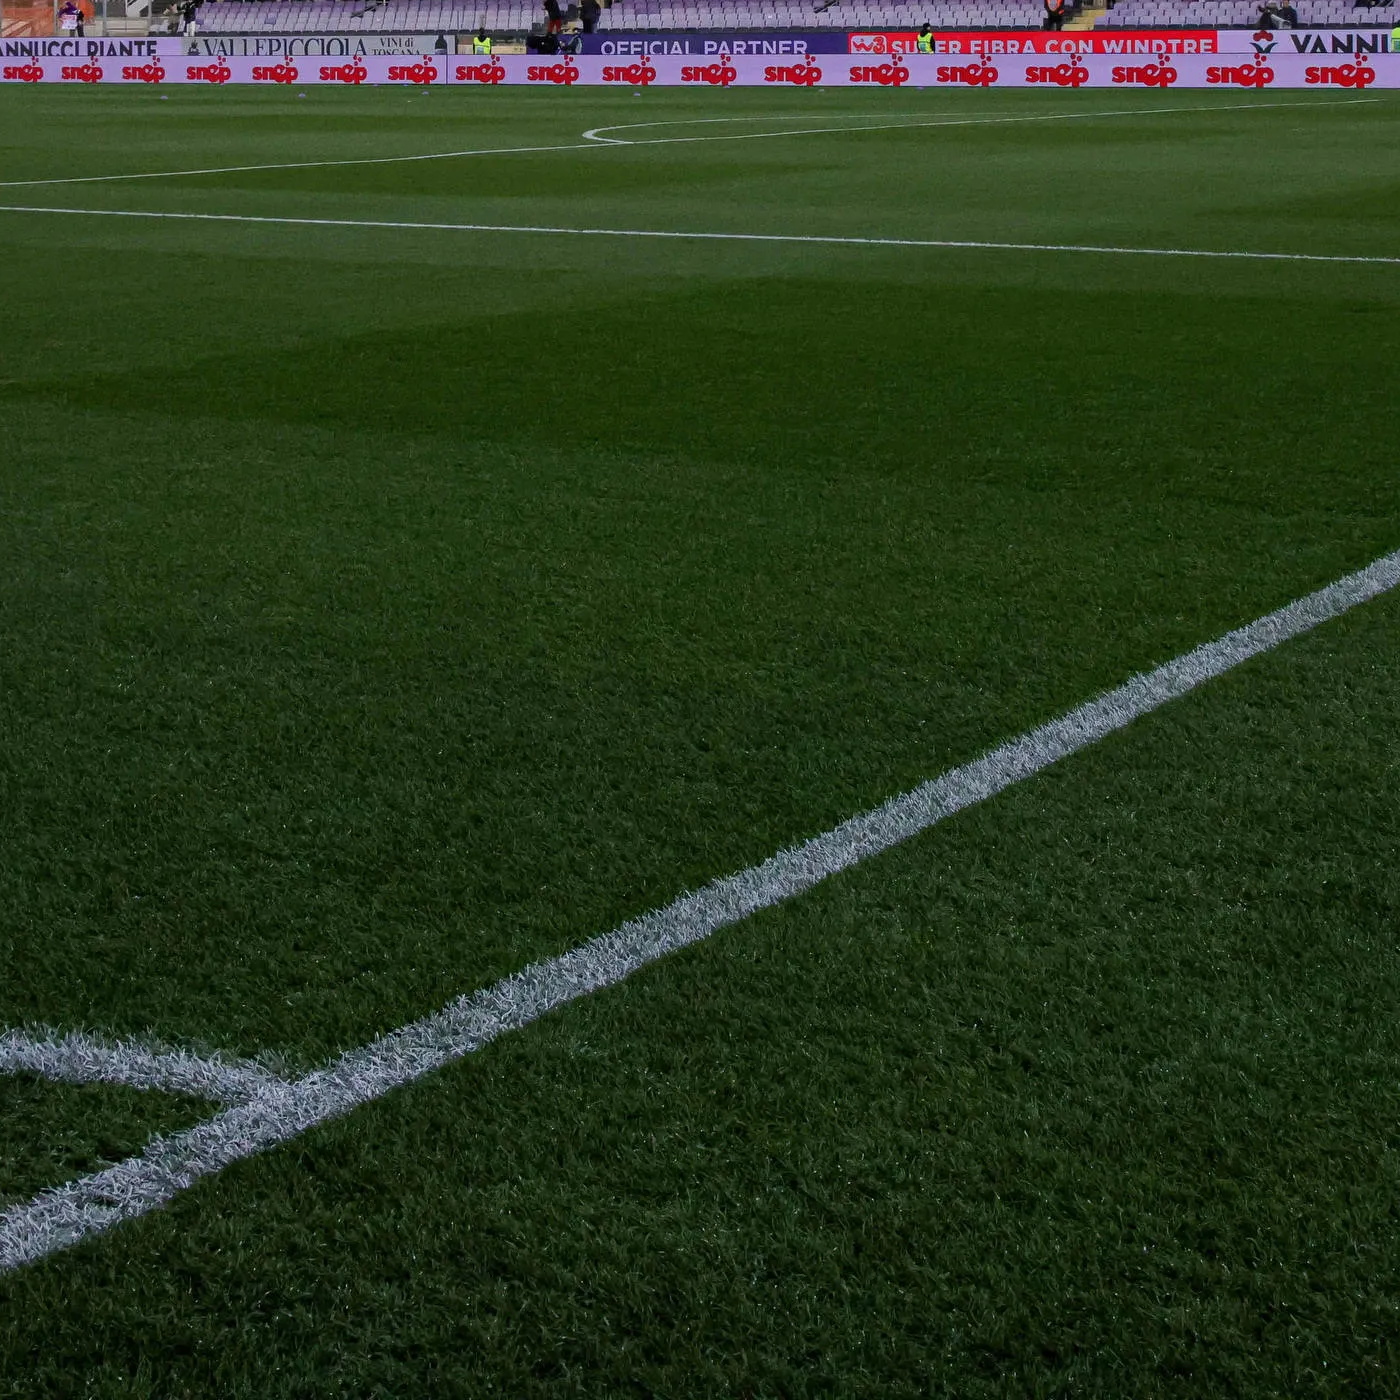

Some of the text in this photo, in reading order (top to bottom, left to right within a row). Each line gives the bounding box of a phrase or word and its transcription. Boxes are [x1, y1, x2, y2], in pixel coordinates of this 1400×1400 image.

[88, 41, 158, 56] PIANTE
[380, 38, 414, 48] VINI di
[600, 40, 808, 54] OFFICIAL PARTNER
[892, 38, 1212, 53] SUER FIBRA CON WINDTRE
[3, 64, 44, 82] snep
[62, 64, 104, 83] snep
[122, 64, 166, 84] snep
[186, 64, 232, 84] snep
[252, 64, 298, 84] snep
[320, 64, 368, 84] snep
[388, 64, 438, 84] snep
[456, 64, 506, 84] snep
[527, 64, 580, 85] snep
[602, 64, 656, 86] snep
[681, 64, 736, 86] snep
[764, 64, 822, 86] snep
[850, 64, 909, 86] snep
[936, 64, 998, 86] snep
[1026, 64, 1089, 87] snep
[1112, 64, 1178, 88] snep
[1206, 64, 1274, 88] snep
[1305, 64, 1376, 88] snep
